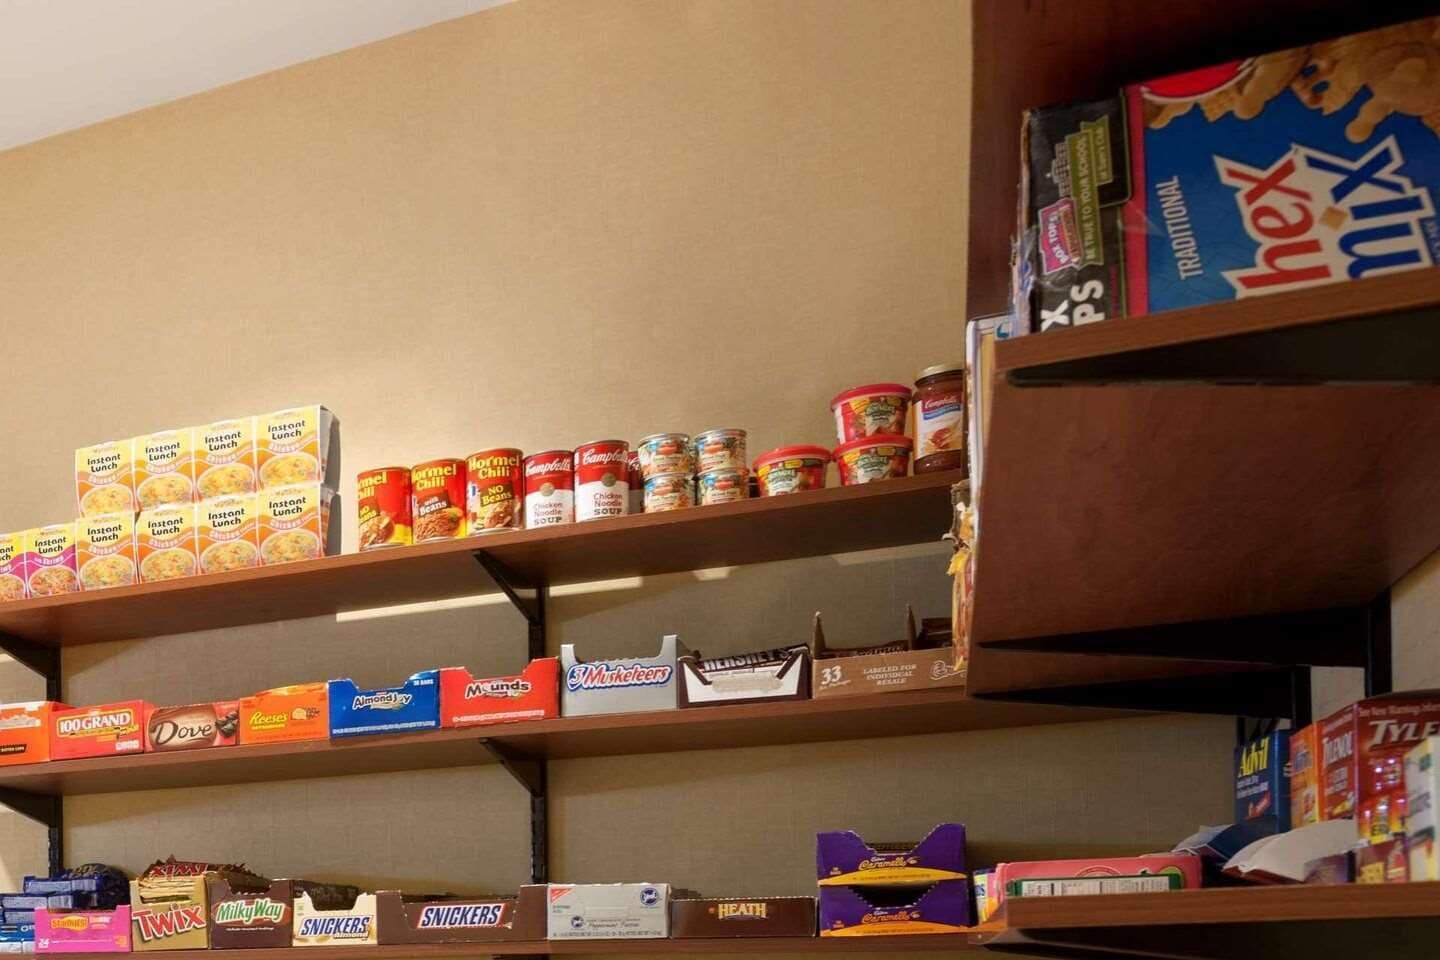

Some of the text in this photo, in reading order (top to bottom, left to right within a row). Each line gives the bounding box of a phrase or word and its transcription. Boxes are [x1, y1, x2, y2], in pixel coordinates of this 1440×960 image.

[1074, 137, 1090, 176] SCHOOL
[1080, 177, 1091, 203] YOUR
[1081, 203, 1092, 216] TO
[1155, 176, 1204, 281] TRADITIONAL
[1224, 157, 1332, 290] hex
[1082, 217, 1095, 246] TRUE
[268, 420, 305, 432] Instant
[205, 431, 241, 444] Instant
[271, 429, 302, 441] Lunch
[145, 442, 181, 453] Instant
[209, 440, 238, 452] Lunch
[87, 453, 121, 465] Instant
[149, 450, 177, 461] Lunch
[90, 462, 117, 473] Lunch
[468, 454, 520, 472] Hormel
[478, 467, 510, 480] Chili
[416, 477, 445, 491] Chili
[488, 484, 503, 496] NO
[269, 496, 306, 509] Instant
[482, 492, 512, 505] Beans
[593, 492, 623, 501] Chicken
[419, 500, 448, 516] Beans
[532, 502, 563, 511] Chicken
[594, 500, 623, 508] Noodle
[208, 508, 245, 521] Instant
[273, 506, 303, 517] Lunch
[533, 509, 563, 518] Noodle
[594, 507, 623, 516] SOUP
[148, 517, 184, 529] Instant
[212, 517, 241, 528] Lunch
[533, 516, 563, 526] SOUP
[87, 524, 122, 536] Instant
[151, 526, 180, 536] Lunch
[35, 537, 66, 548] Instant
[91, 533, 119, 543] Lunch
[38, 545, 64, 555] Lunch
[570, 664, 672, 686] 3 Musketeers
[820, 665, 842, 685] 33
[863, 663, 917, 675] LABELED FOR
[866, 671, 913, 680] INDIVIDUAL
[876, 677, 907, 686] RESALE
[466, 680, 531, 699] Mounds
[353, 693, 393, 710] Almond
[60, 712, 131, 734] 100 GRAND
[249, 711, 289, 725] Reese's
[153, 719, 212, 745] Dove
[1238, 736, 1270, 778] Advil
[216, 898, 285, 924] Milky Way
[421, 905, 502, 927] SNICKERS
[717, 902, 766, 919] HEATH
[300, 915, 371, 936] SNICKERS
